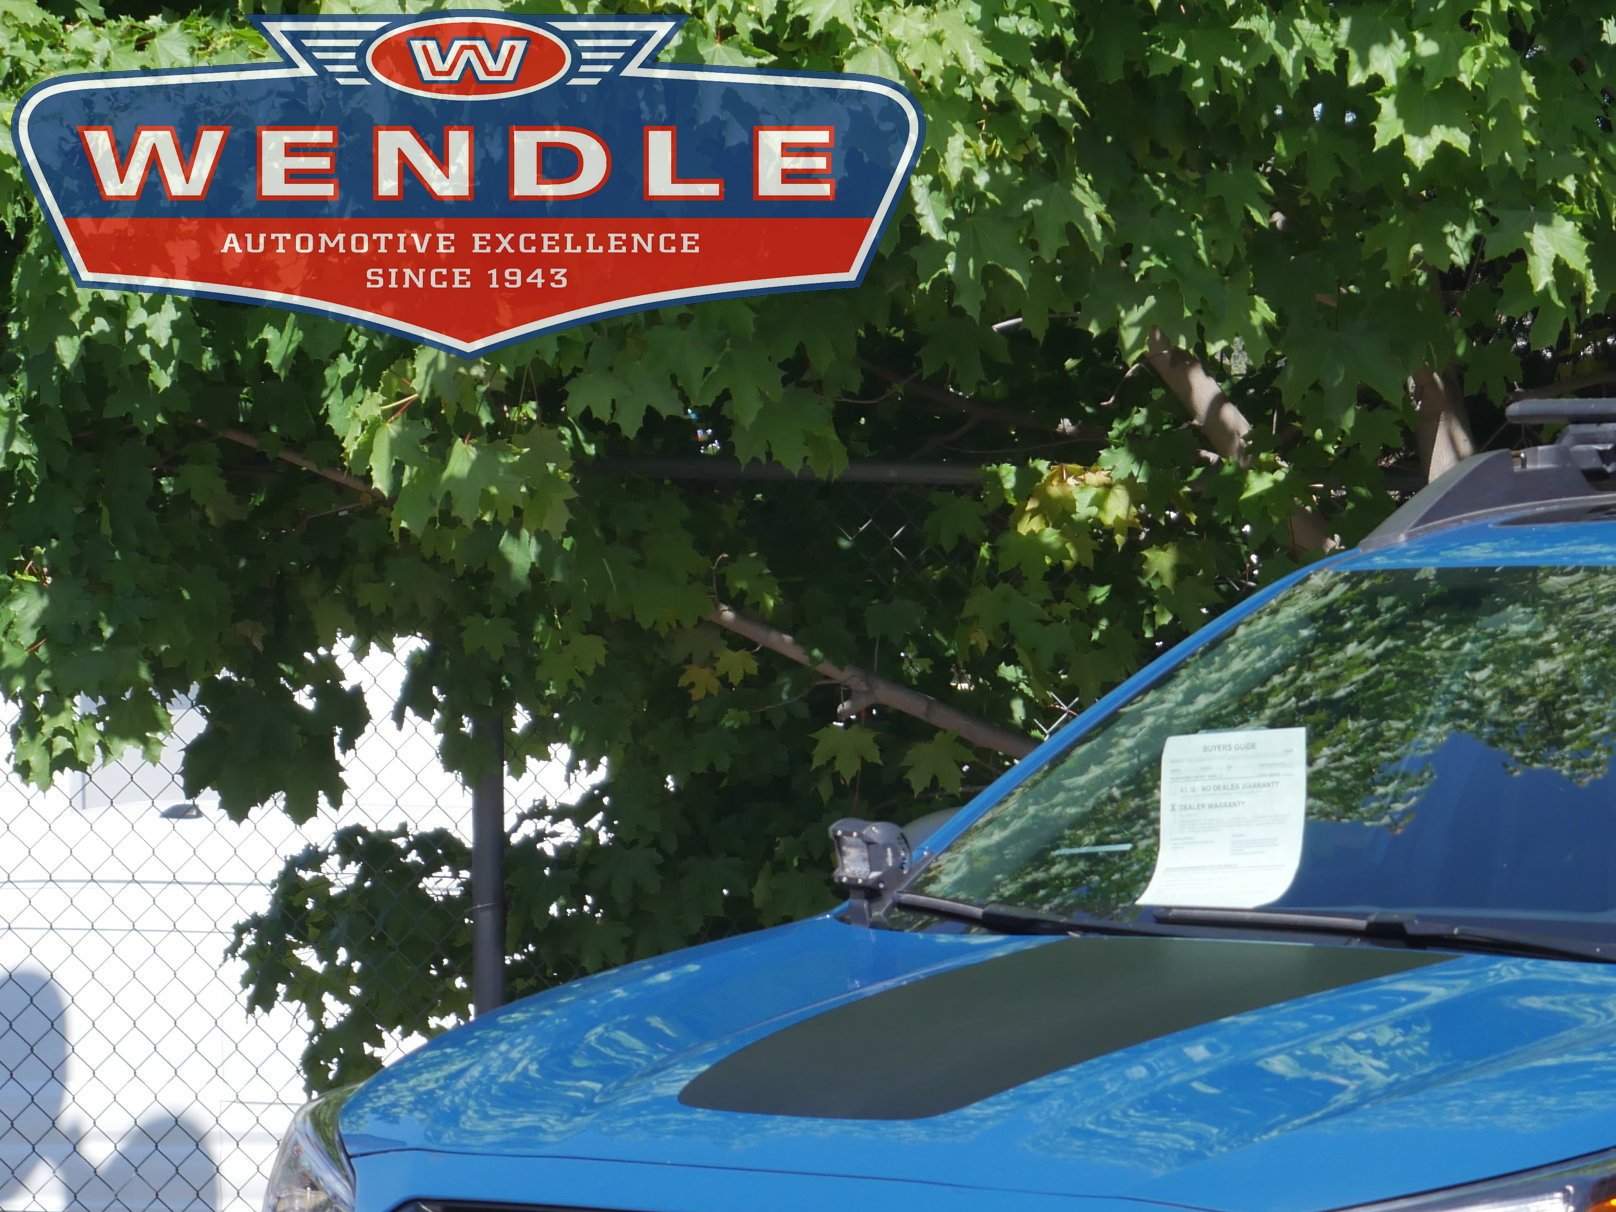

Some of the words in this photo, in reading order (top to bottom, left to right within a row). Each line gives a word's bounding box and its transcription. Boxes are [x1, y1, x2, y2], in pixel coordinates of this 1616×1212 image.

[1202, 743, 1232, 753] BUYERS
[1234, 742, 1257, 751] GUIDE
[1212, 783, 1240, 792] DEALER
[1242, 781, 1279, 790] WARRANTY
[1179, 802, 1207, 812] DEALER
[1208, 801, 1246, 810] WARRANTY
